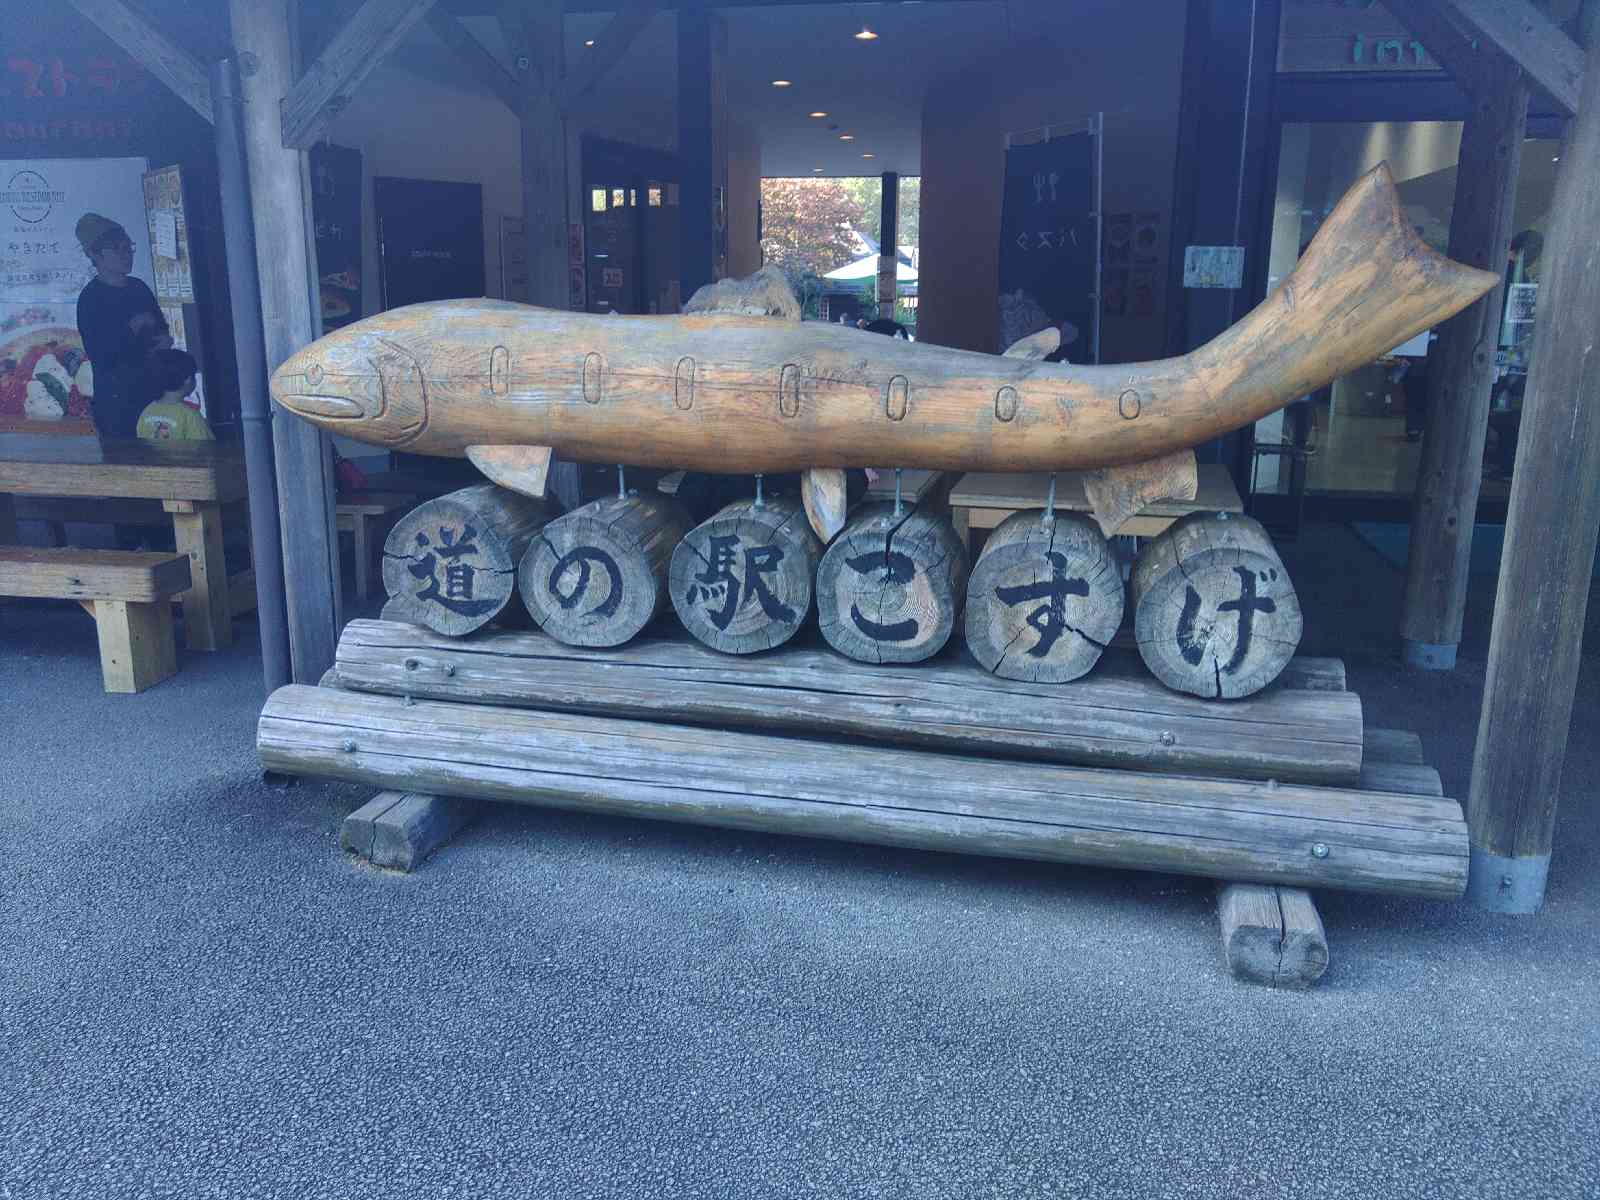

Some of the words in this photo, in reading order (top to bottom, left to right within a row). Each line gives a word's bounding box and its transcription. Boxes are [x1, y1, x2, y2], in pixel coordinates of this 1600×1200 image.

[408, 522, 1277, 676] 道の駅こすげ
